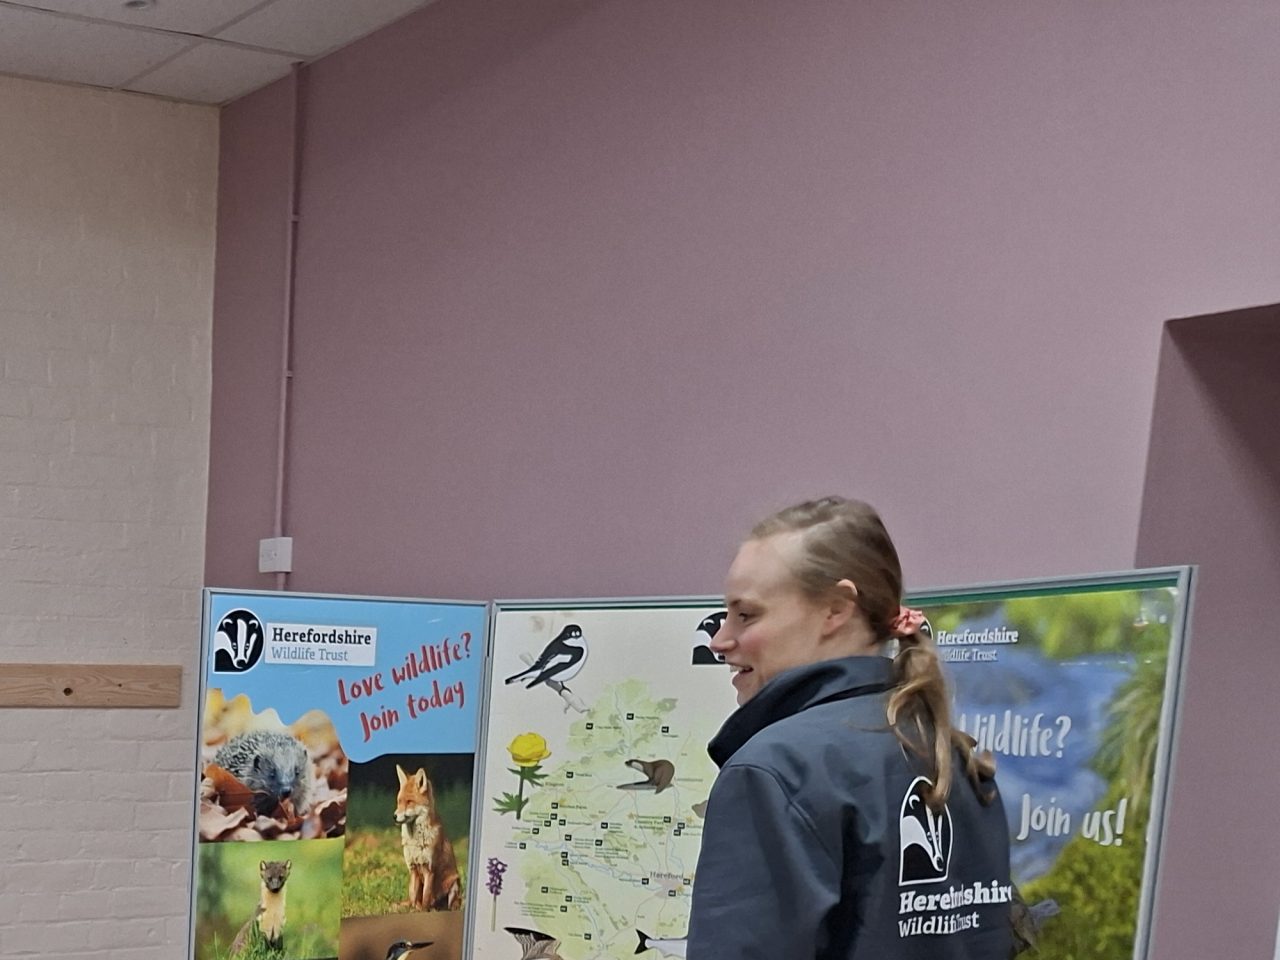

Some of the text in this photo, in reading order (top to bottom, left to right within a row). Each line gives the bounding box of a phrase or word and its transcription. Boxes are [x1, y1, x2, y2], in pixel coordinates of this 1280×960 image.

[271, 627, 372, 646] Herefordshire
[937, 626, 1019, 646] Herefordshire
[271, 646, 349, 662] Wildlife Trust
[971, 648, 998, 662] Trust
[338, 631, 472, 705] Love wildlife?
[360, 680, 465, 743] Join today
[1016, 793, 1128, 846] Join us!
[898, 914, 957, 938] Wildlif
